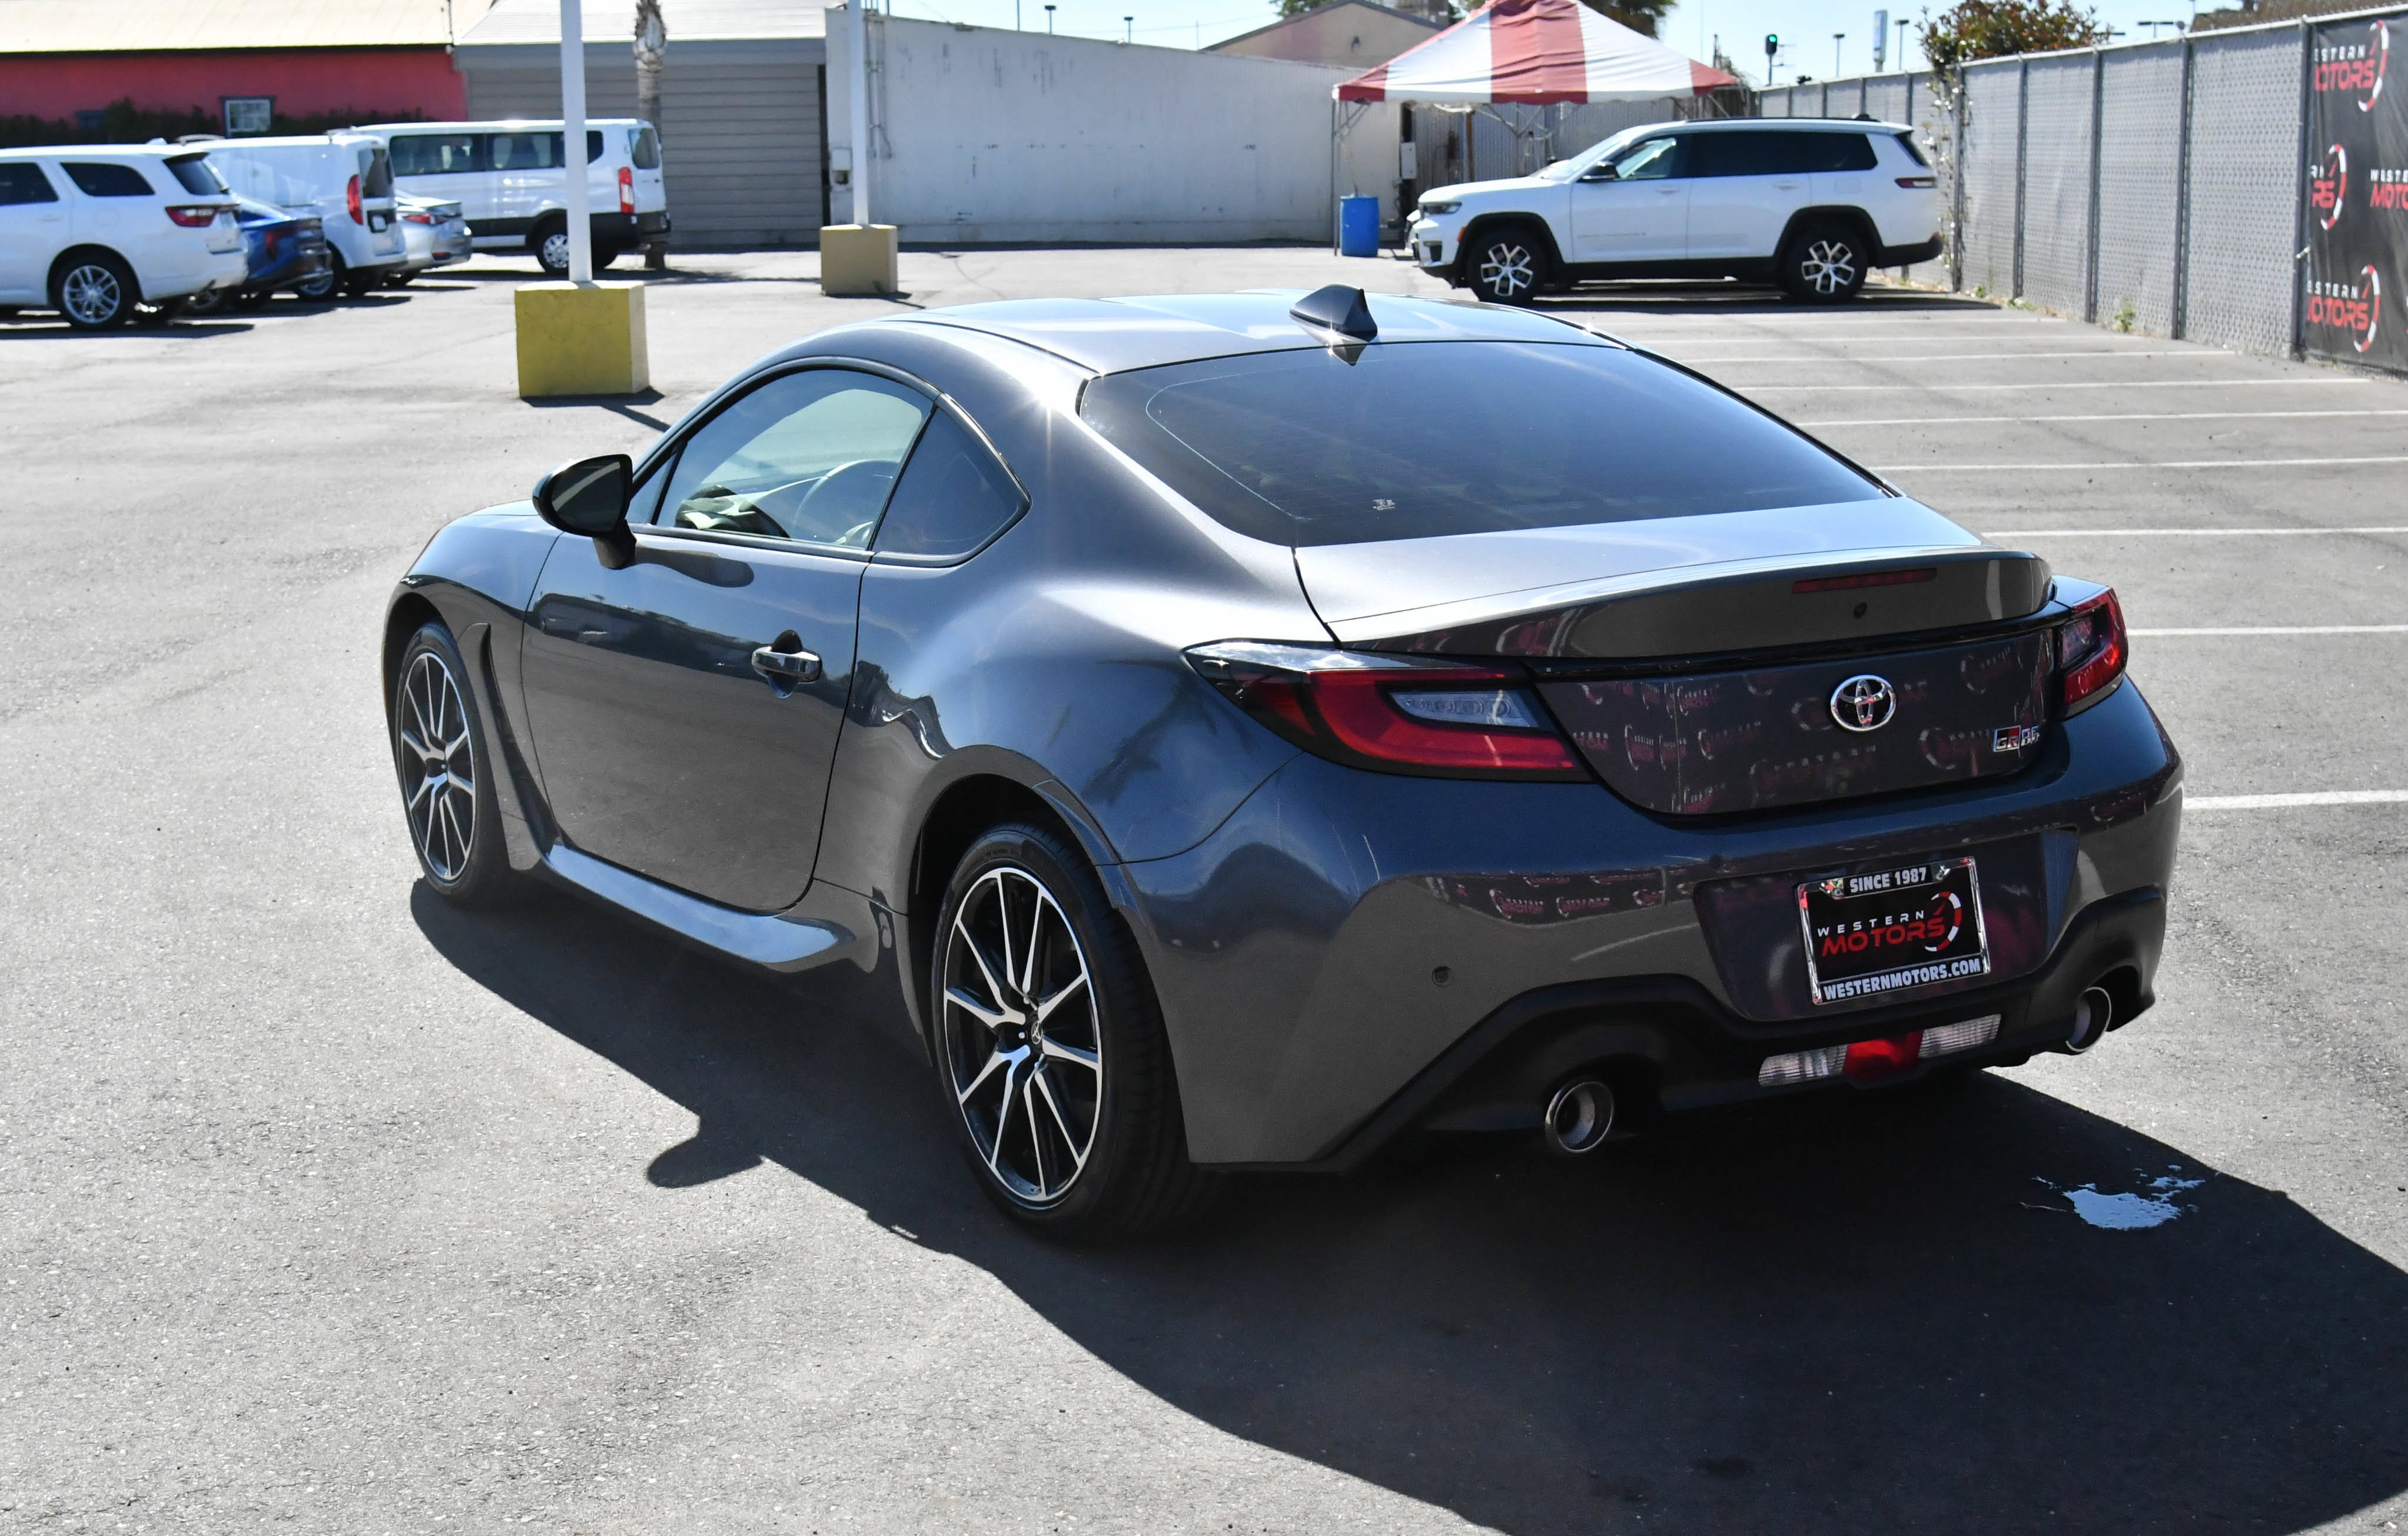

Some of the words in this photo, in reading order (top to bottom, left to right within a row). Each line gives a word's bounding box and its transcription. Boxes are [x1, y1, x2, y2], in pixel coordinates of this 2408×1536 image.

[1850, 872, 1891, 894] SINCE
[1894, 867, 1927, 885] 1987
[1818, 910, 1924, 938] WESTERN
[1822, 917, 1945, 957] MOTORS
[1824, 958, 1981, 1000] WESTERNMOTORS.COM
